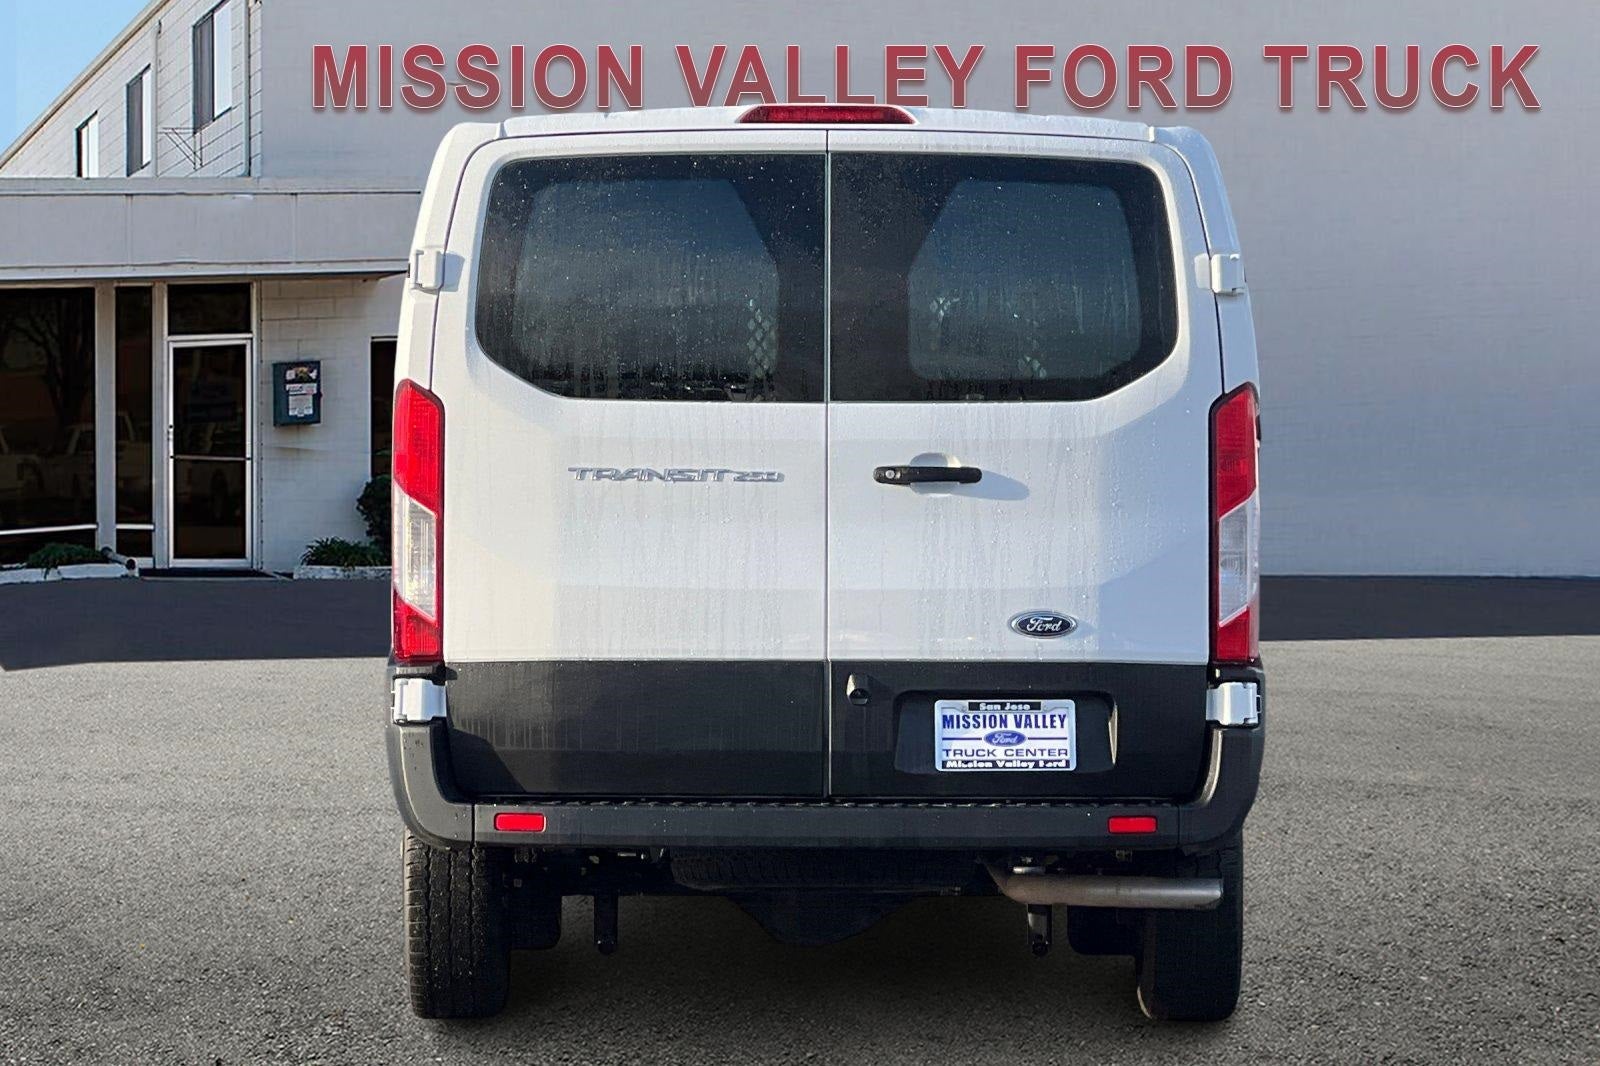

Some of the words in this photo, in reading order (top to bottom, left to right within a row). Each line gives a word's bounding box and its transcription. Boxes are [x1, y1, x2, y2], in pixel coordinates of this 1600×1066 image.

[311, 44, 644, 109] MISSION
[675, 44, 985, 108] VALLEY
[1014, 43, 1234, 109] FORD
[1263, 43, 1541, 109] TRUCK
[1026, 616, 1063, 631] Ford
[979, 702, 1001, 711] San
[1004, 702, 1031, 711] Jose
[942, 714, 1008, 729] MISSION
[1013, 714, 1067, 729] VALLEY
[992, 732, 1019, 744] Ford
[943, 749, 997, 757] TRUCK
[1004, 749, 1068, 757] CENTER
[945, 760, 993, 768] Mission
[996, 760, 1036, 769] Valley
